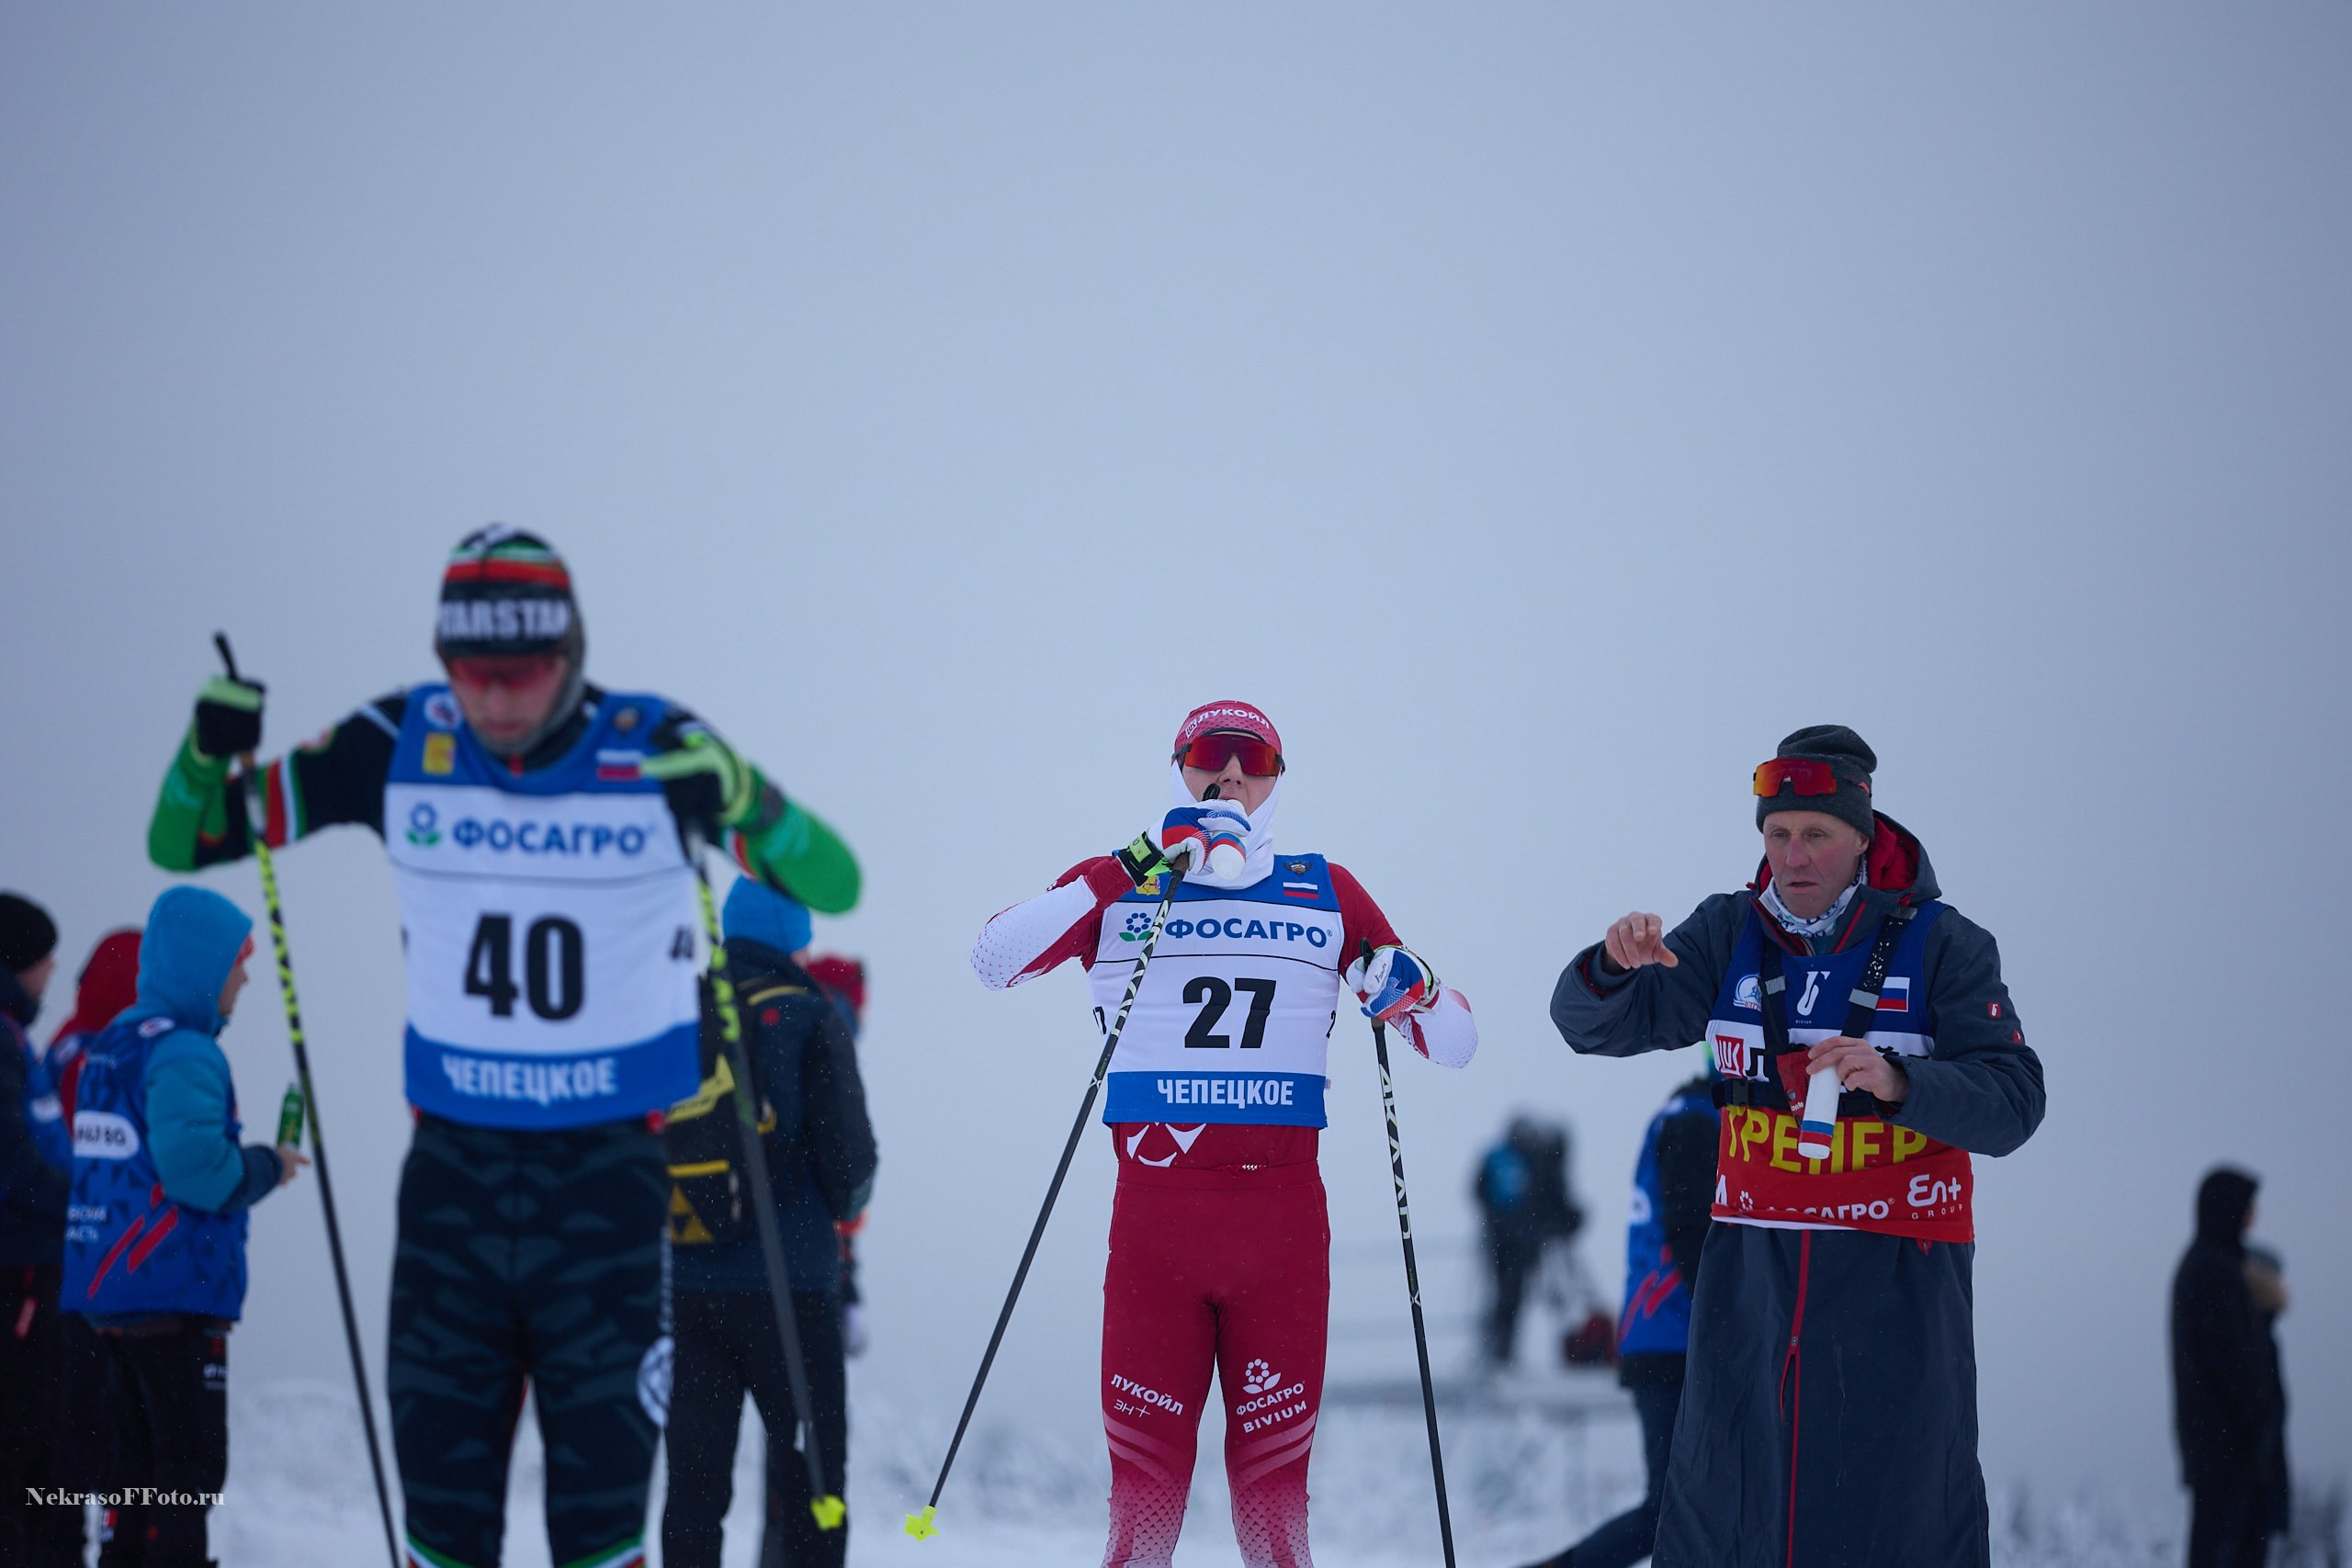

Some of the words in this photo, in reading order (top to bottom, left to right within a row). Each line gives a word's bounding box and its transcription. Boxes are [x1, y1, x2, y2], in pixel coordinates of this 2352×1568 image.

[1197, 708, 1271, 729] ЛУКОЙЛ
[452, 818, 645, 857] ФОСАГРО
[1165, 918, 1328, 949] ФОСАГРО
[464, 912, 585, 1021] 40
[1182, 976, 1277, 1049] 27
[442, 1054, 617, 1105] ЧЕПЕЦКОЕ
[1158, 1079, 1295, 1109] ЧЕПЕЦКОЕ
[1725, 1104, 1928, 1176] ТРЕНЕР
[1768, 1200, 1890, 1221] АГРО
[1911, 1203, 1963, 1220] GROUP
[1110, 1373, 1184, 1416] ЛУКОЙЛ
[1236, 1382, 1306, 1416] ФОСАГРО
[1243, 1400, 1308, 1434] BIVIUM
